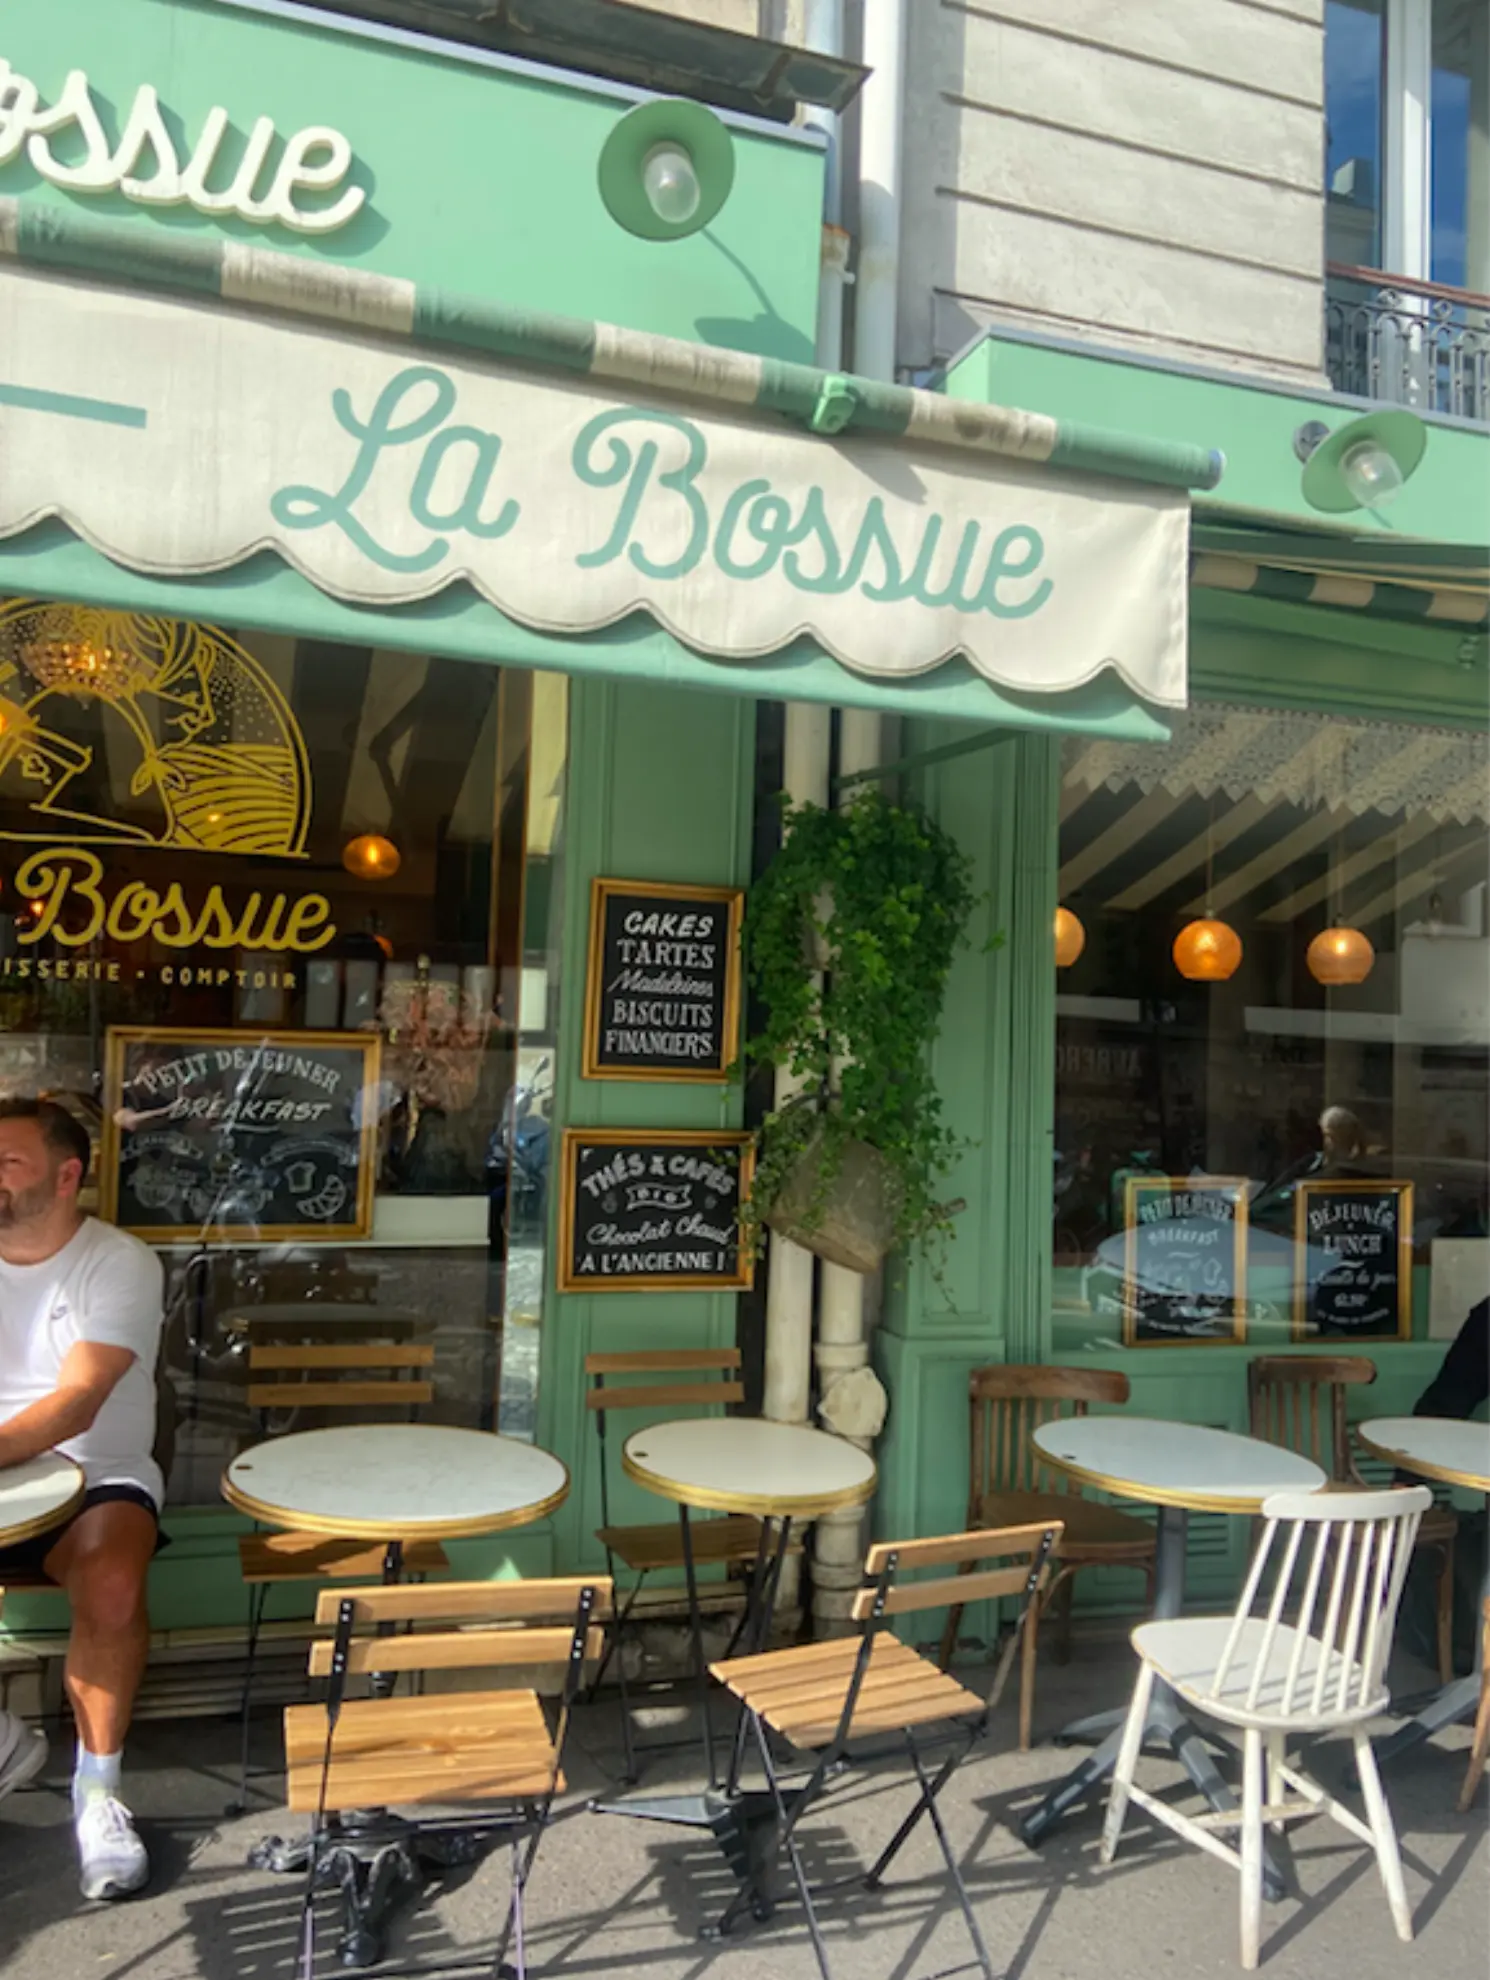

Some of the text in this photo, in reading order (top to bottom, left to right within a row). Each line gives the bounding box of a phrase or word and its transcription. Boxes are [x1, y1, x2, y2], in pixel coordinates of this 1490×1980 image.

[269, 366, 1053, 620] La Bossue
[15, 848, 337, 951] Bossue
[623, 910, 714, 938] CAKES
[616, 938, 716, 969] TARTES
[4, 957, 297, 990] ISSERIE COMPTOIR
[612, 999, 713, 1027] BISCUITS
[604, 1027, 713, 1059] FINANCIERS
[140, 1052, 209, 1094] PETIT
[169, 1096, 332, 1121] BREAKFAST
[581, 1152, 735, 1198] THÉS & CAFÉS
[586, 1218, 671, 1246] Chocolat
[1323, 1234, 1381, 1256] LUNCH
[601, 1251, 713, 1273] L'ANCIENNE
